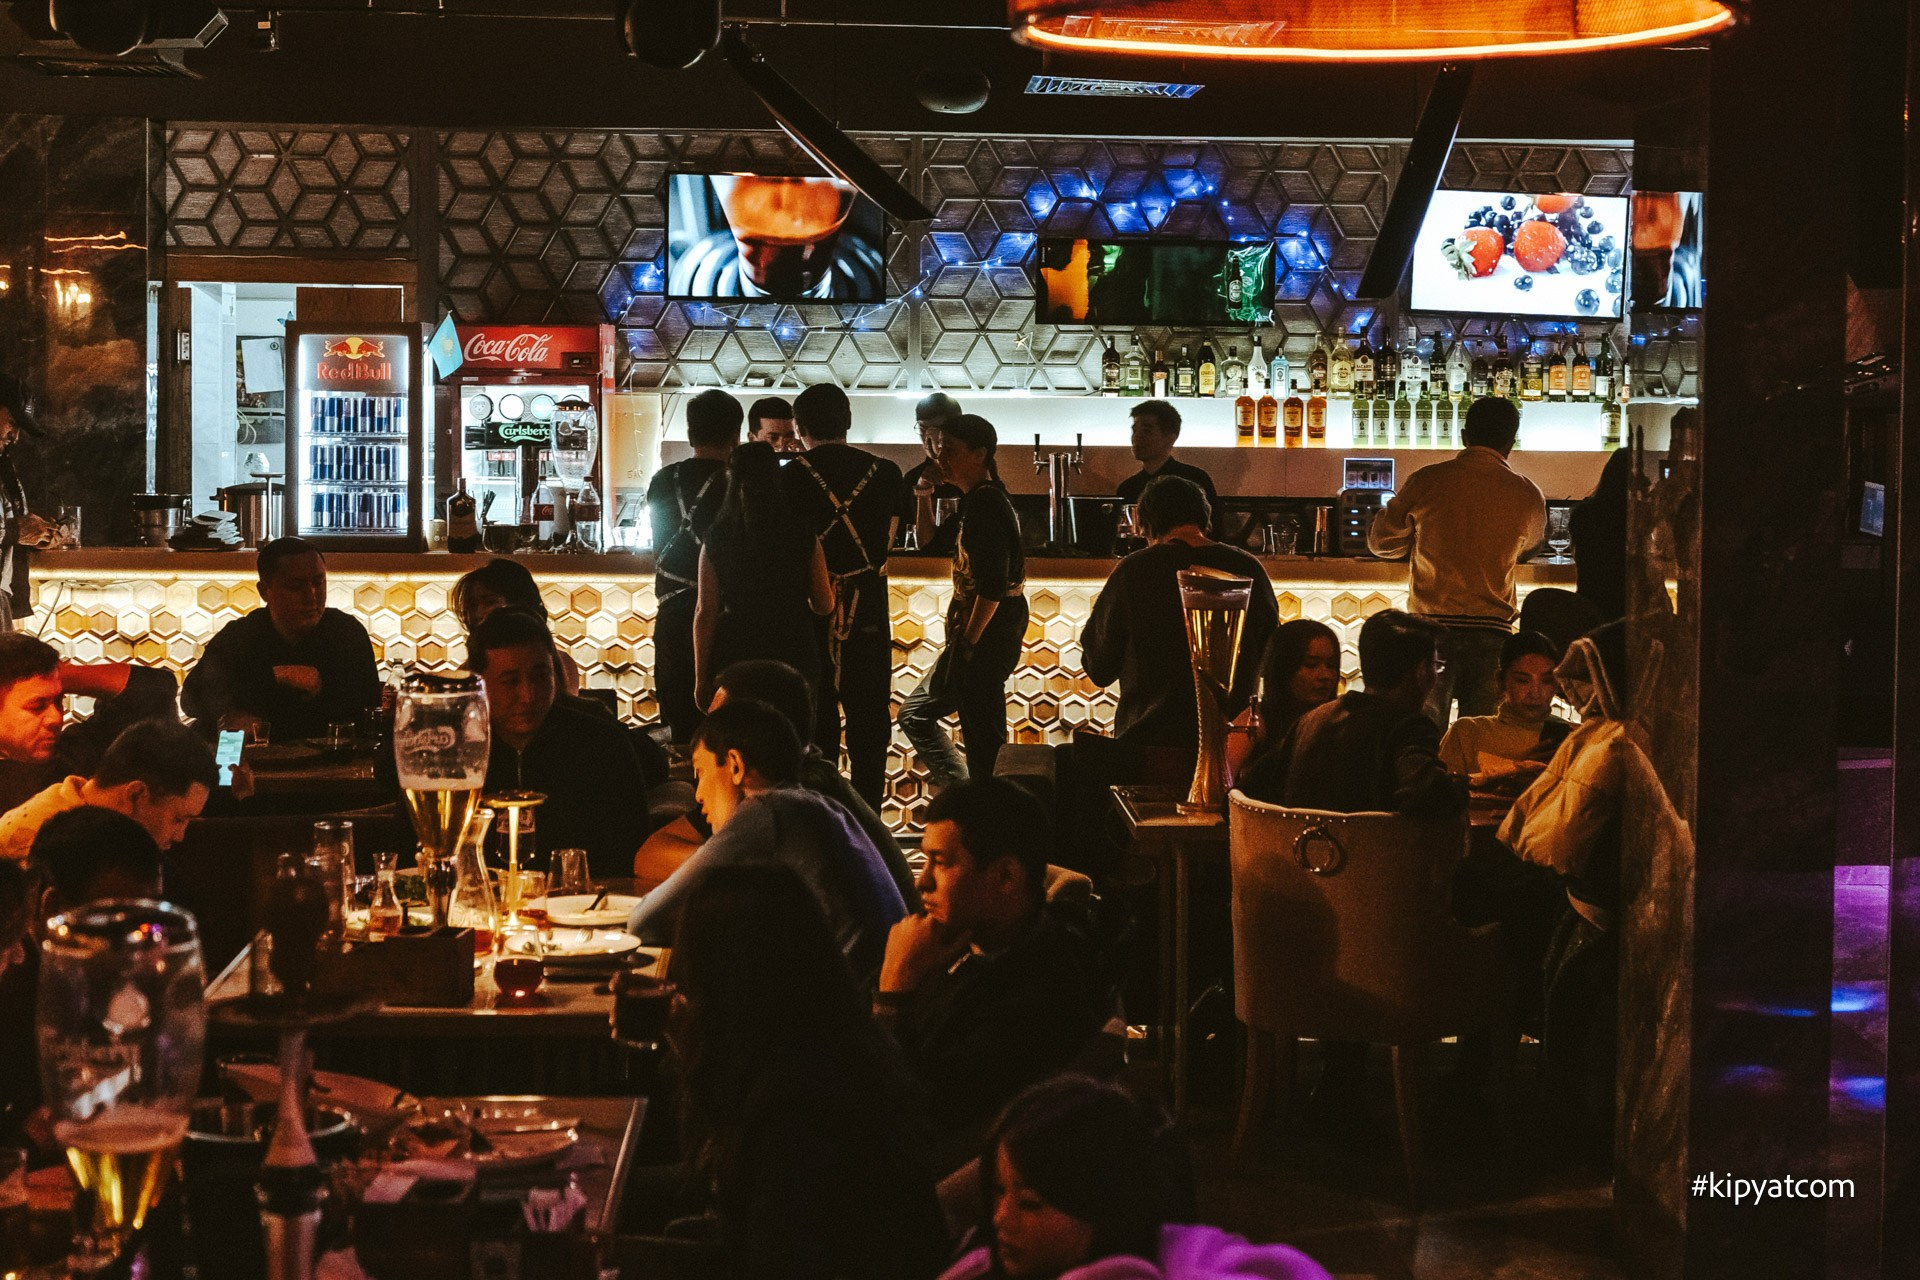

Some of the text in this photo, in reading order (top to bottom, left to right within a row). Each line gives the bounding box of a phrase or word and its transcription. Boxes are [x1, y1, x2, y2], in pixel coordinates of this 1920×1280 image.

[463, 332, 553, 362] Coca-Cola
[317, 362, 392, 380] Red Bull
